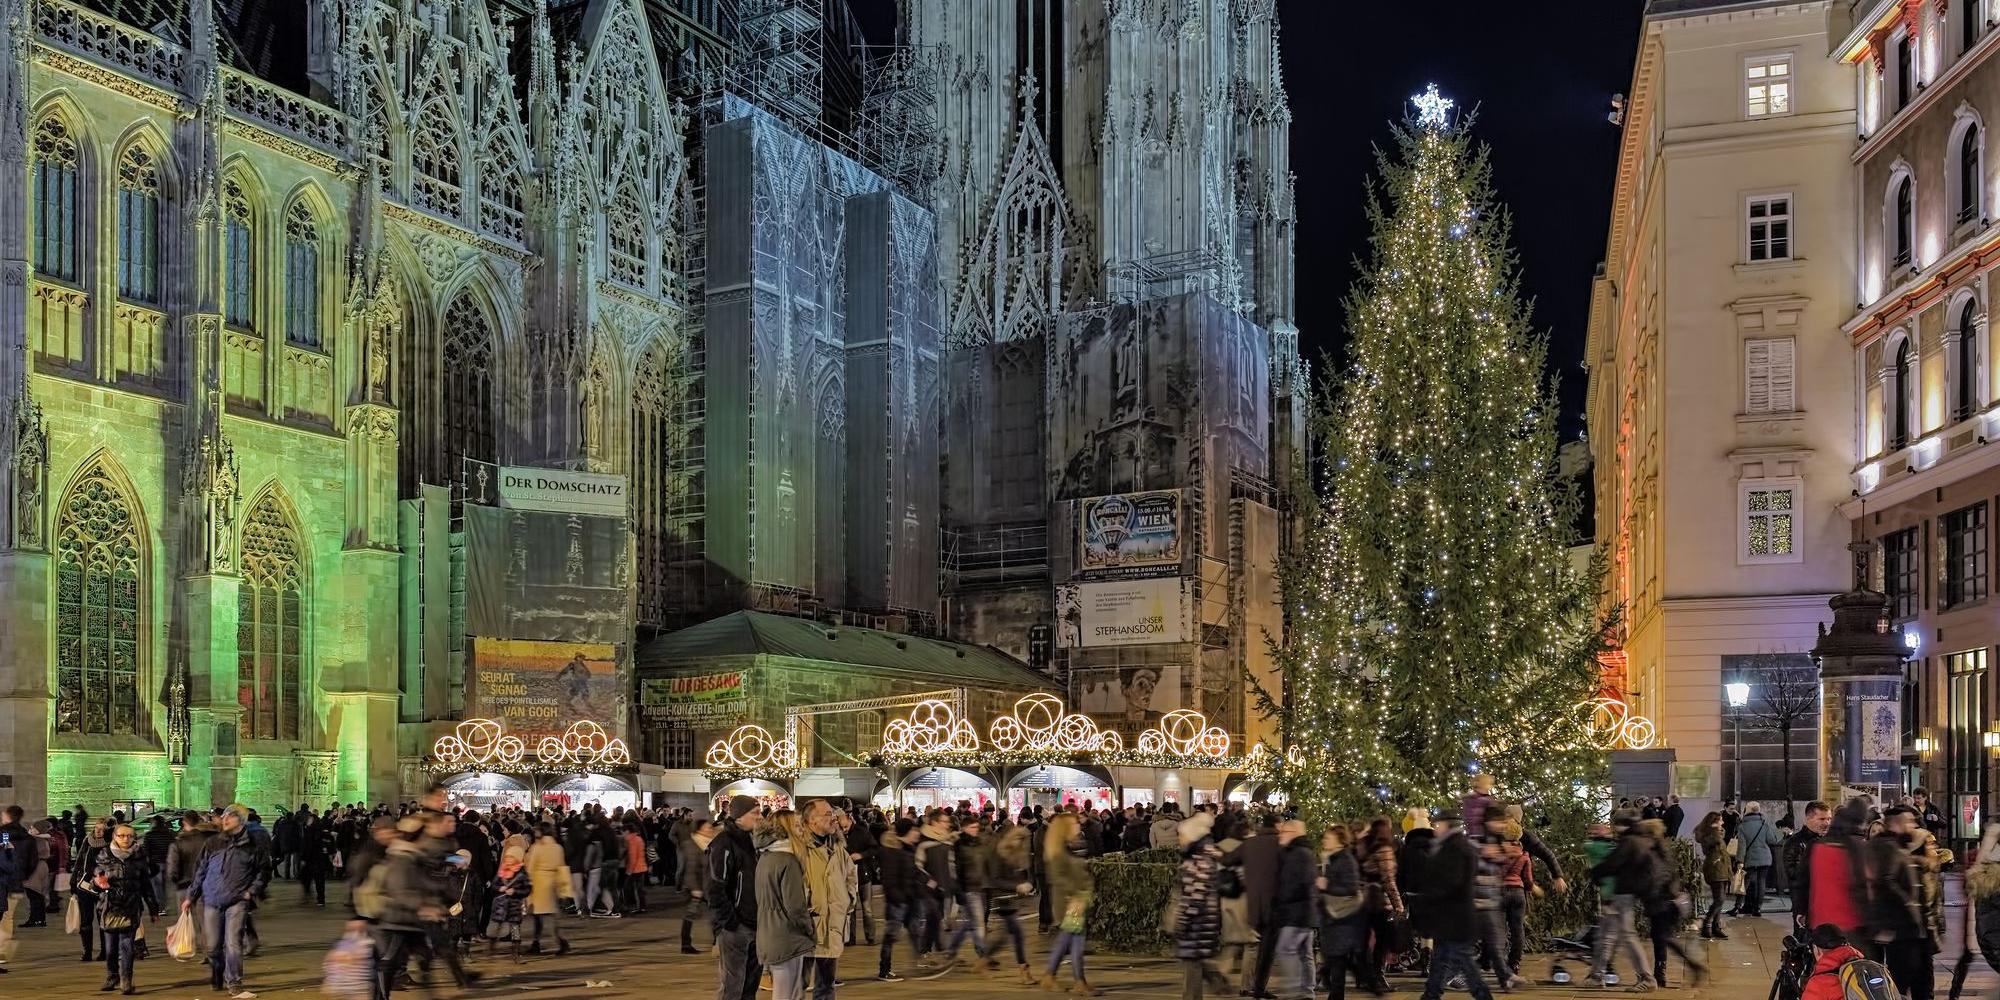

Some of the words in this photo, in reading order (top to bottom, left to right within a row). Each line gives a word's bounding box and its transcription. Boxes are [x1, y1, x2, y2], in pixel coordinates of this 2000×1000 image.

[505, 475, 533, 489] DER
[537, 478, 622, 496] DOMSCHATZ
[1138, 513, 1170, 526] WIEN
[1138, 616, 1163, 625] UNSER
[1095, 624, 1164, 637] STEPHANSDOM
[480, 671, 516, 683] SEURAT
[671, 671, 741, 694] LOBGESANG
[490, 684, 528, 696] SIGNAC
[503, 706, 526, 717] VAN
[528, 707, 558, 718] GOGH
[728, 700, 747, 714] DOM
